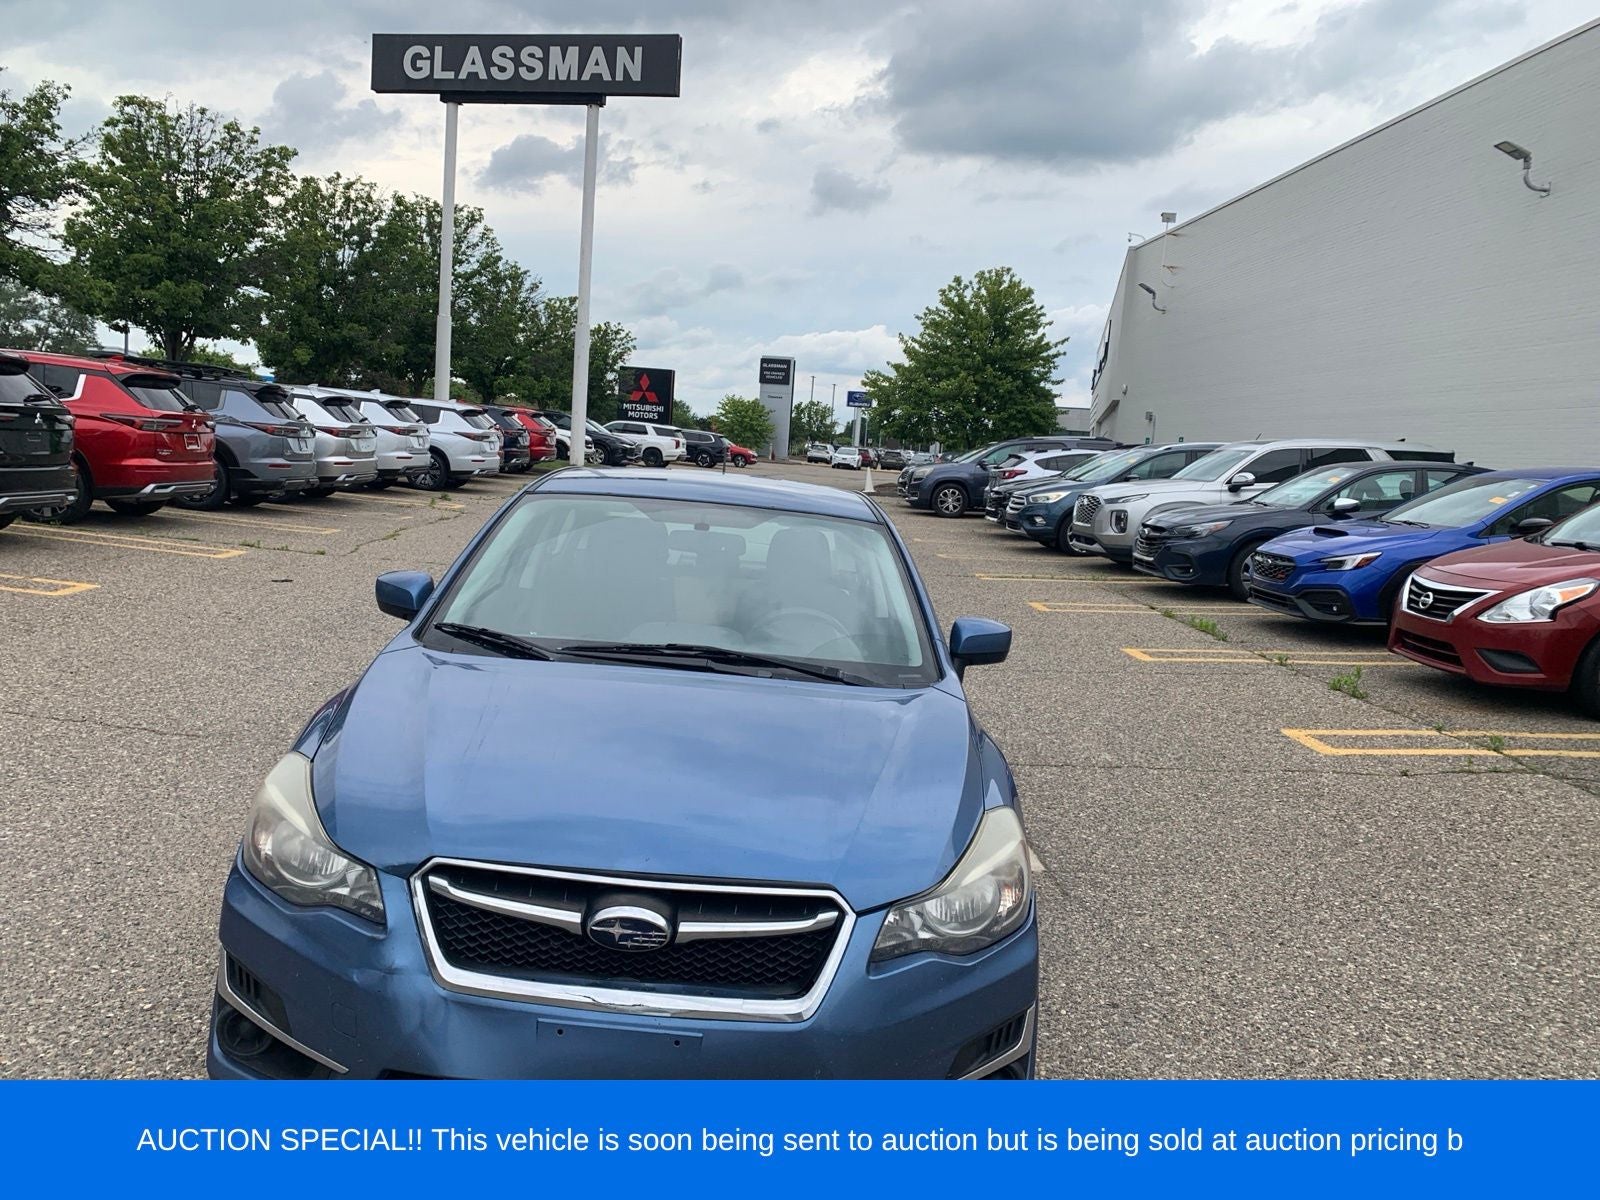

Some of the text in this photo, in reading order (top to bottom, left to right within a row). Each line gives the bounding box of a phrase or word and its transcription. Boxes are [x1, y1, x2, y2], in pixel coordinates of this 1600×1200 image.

[402, 45, 643, 81] GLASSMAN
[623, 403, 664, 412] MITSUBISHI
[628, 411, 658, 420] MOTORS
